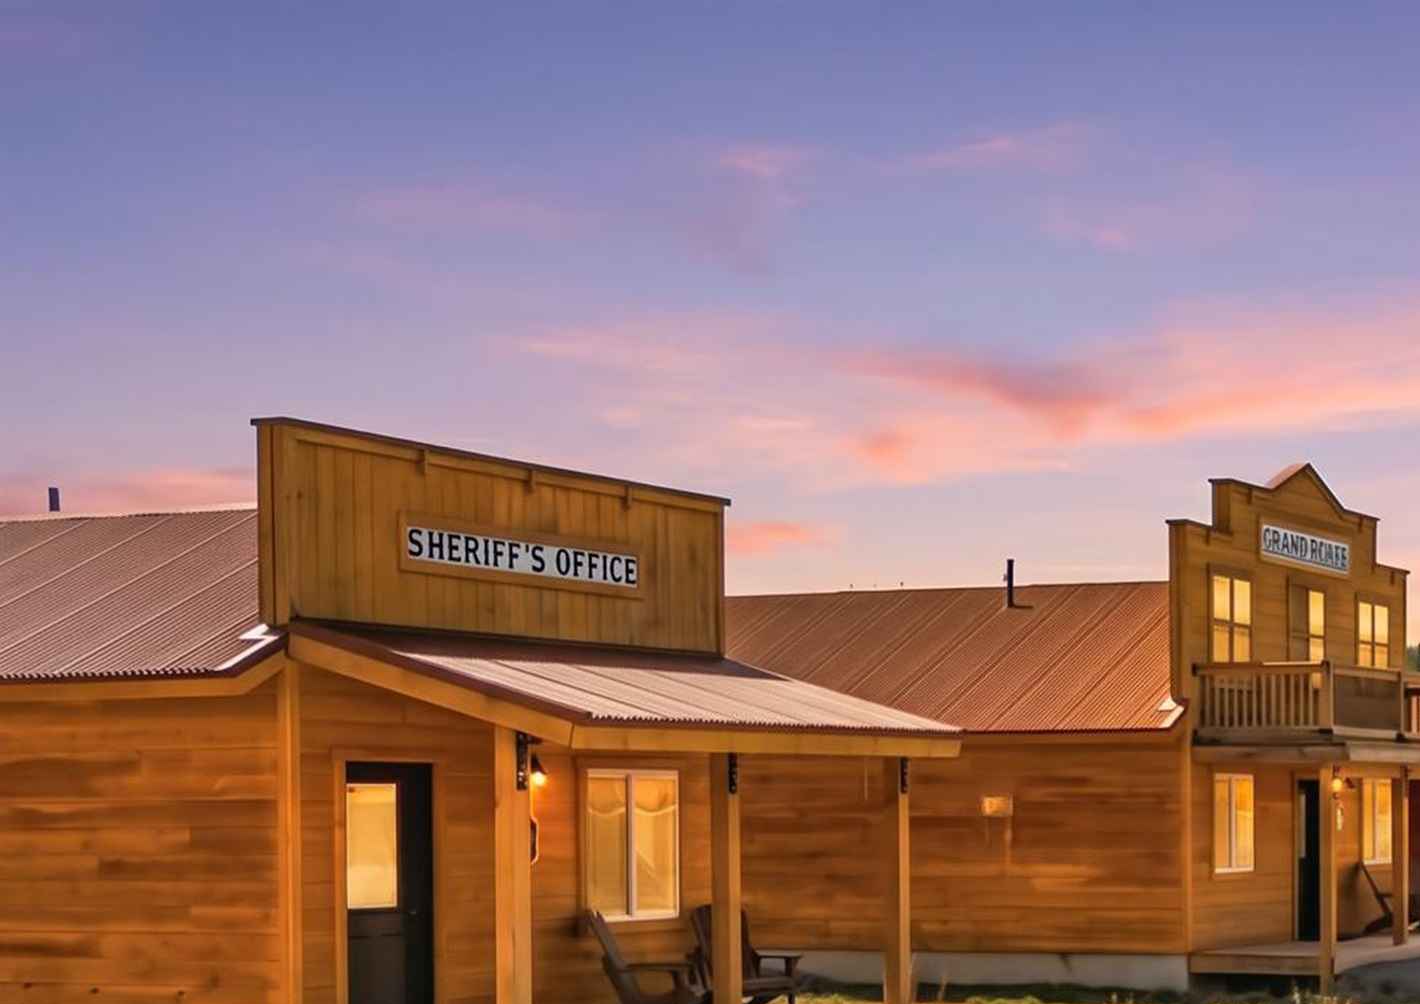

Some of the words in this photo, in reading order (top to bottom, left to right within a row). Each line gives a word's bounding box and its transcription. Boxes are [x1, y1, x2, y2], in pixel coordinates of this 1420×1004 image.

[408, 528, 546, 573] SHERIFF'S
[556, 548, 637, 585] OFFICE
[1263, 527, 1308, 558] GRAND
